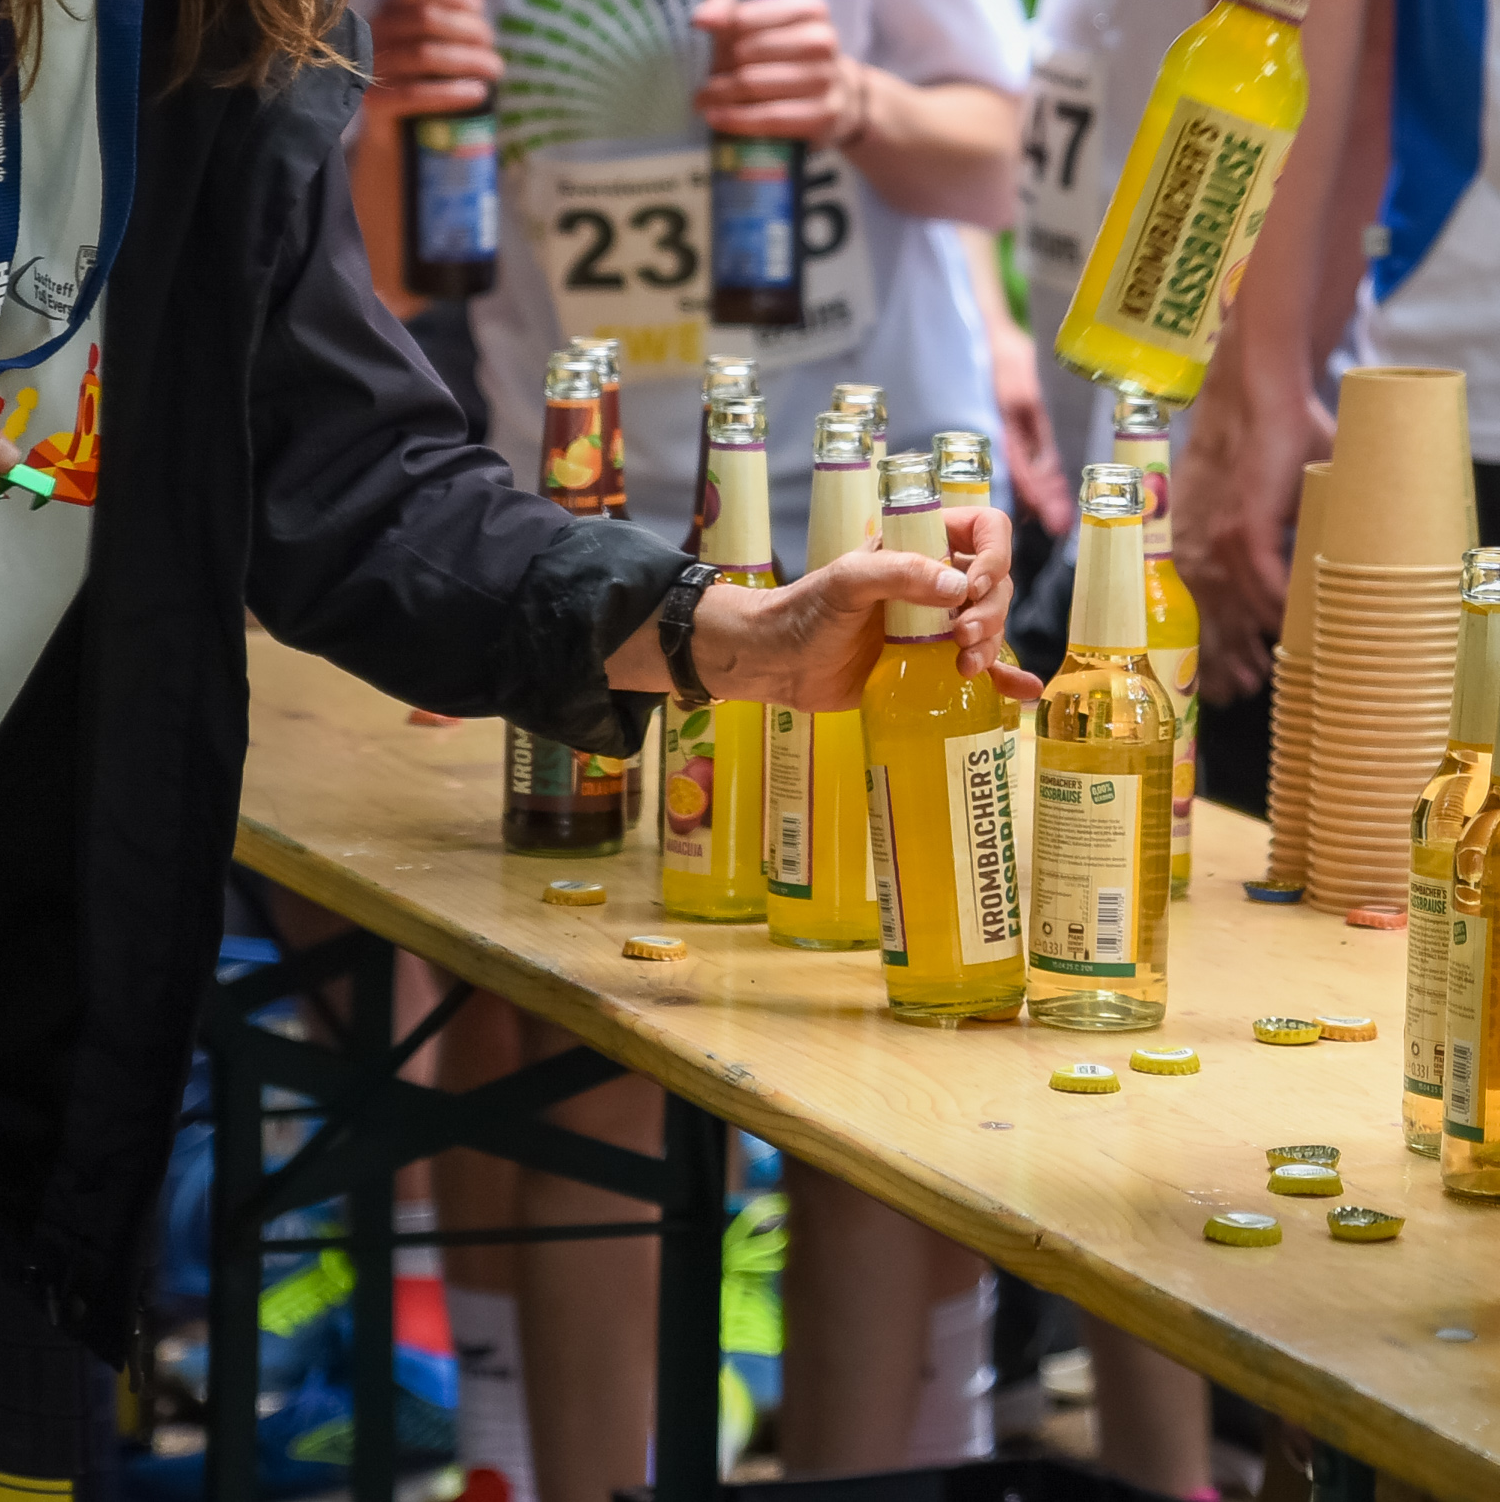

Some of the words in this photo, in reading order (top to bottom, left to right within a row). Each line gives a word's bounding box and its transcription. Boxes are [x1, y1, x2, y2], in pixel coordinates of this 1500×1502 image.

[556, 169, 850, 294] 235
[1151, 131, 1266, 339] FASSBRAUSE
[968, 749, 1006, 945] KROMBACHER'S
[1040, 785, 1083, 804] FASSBRAUSE
